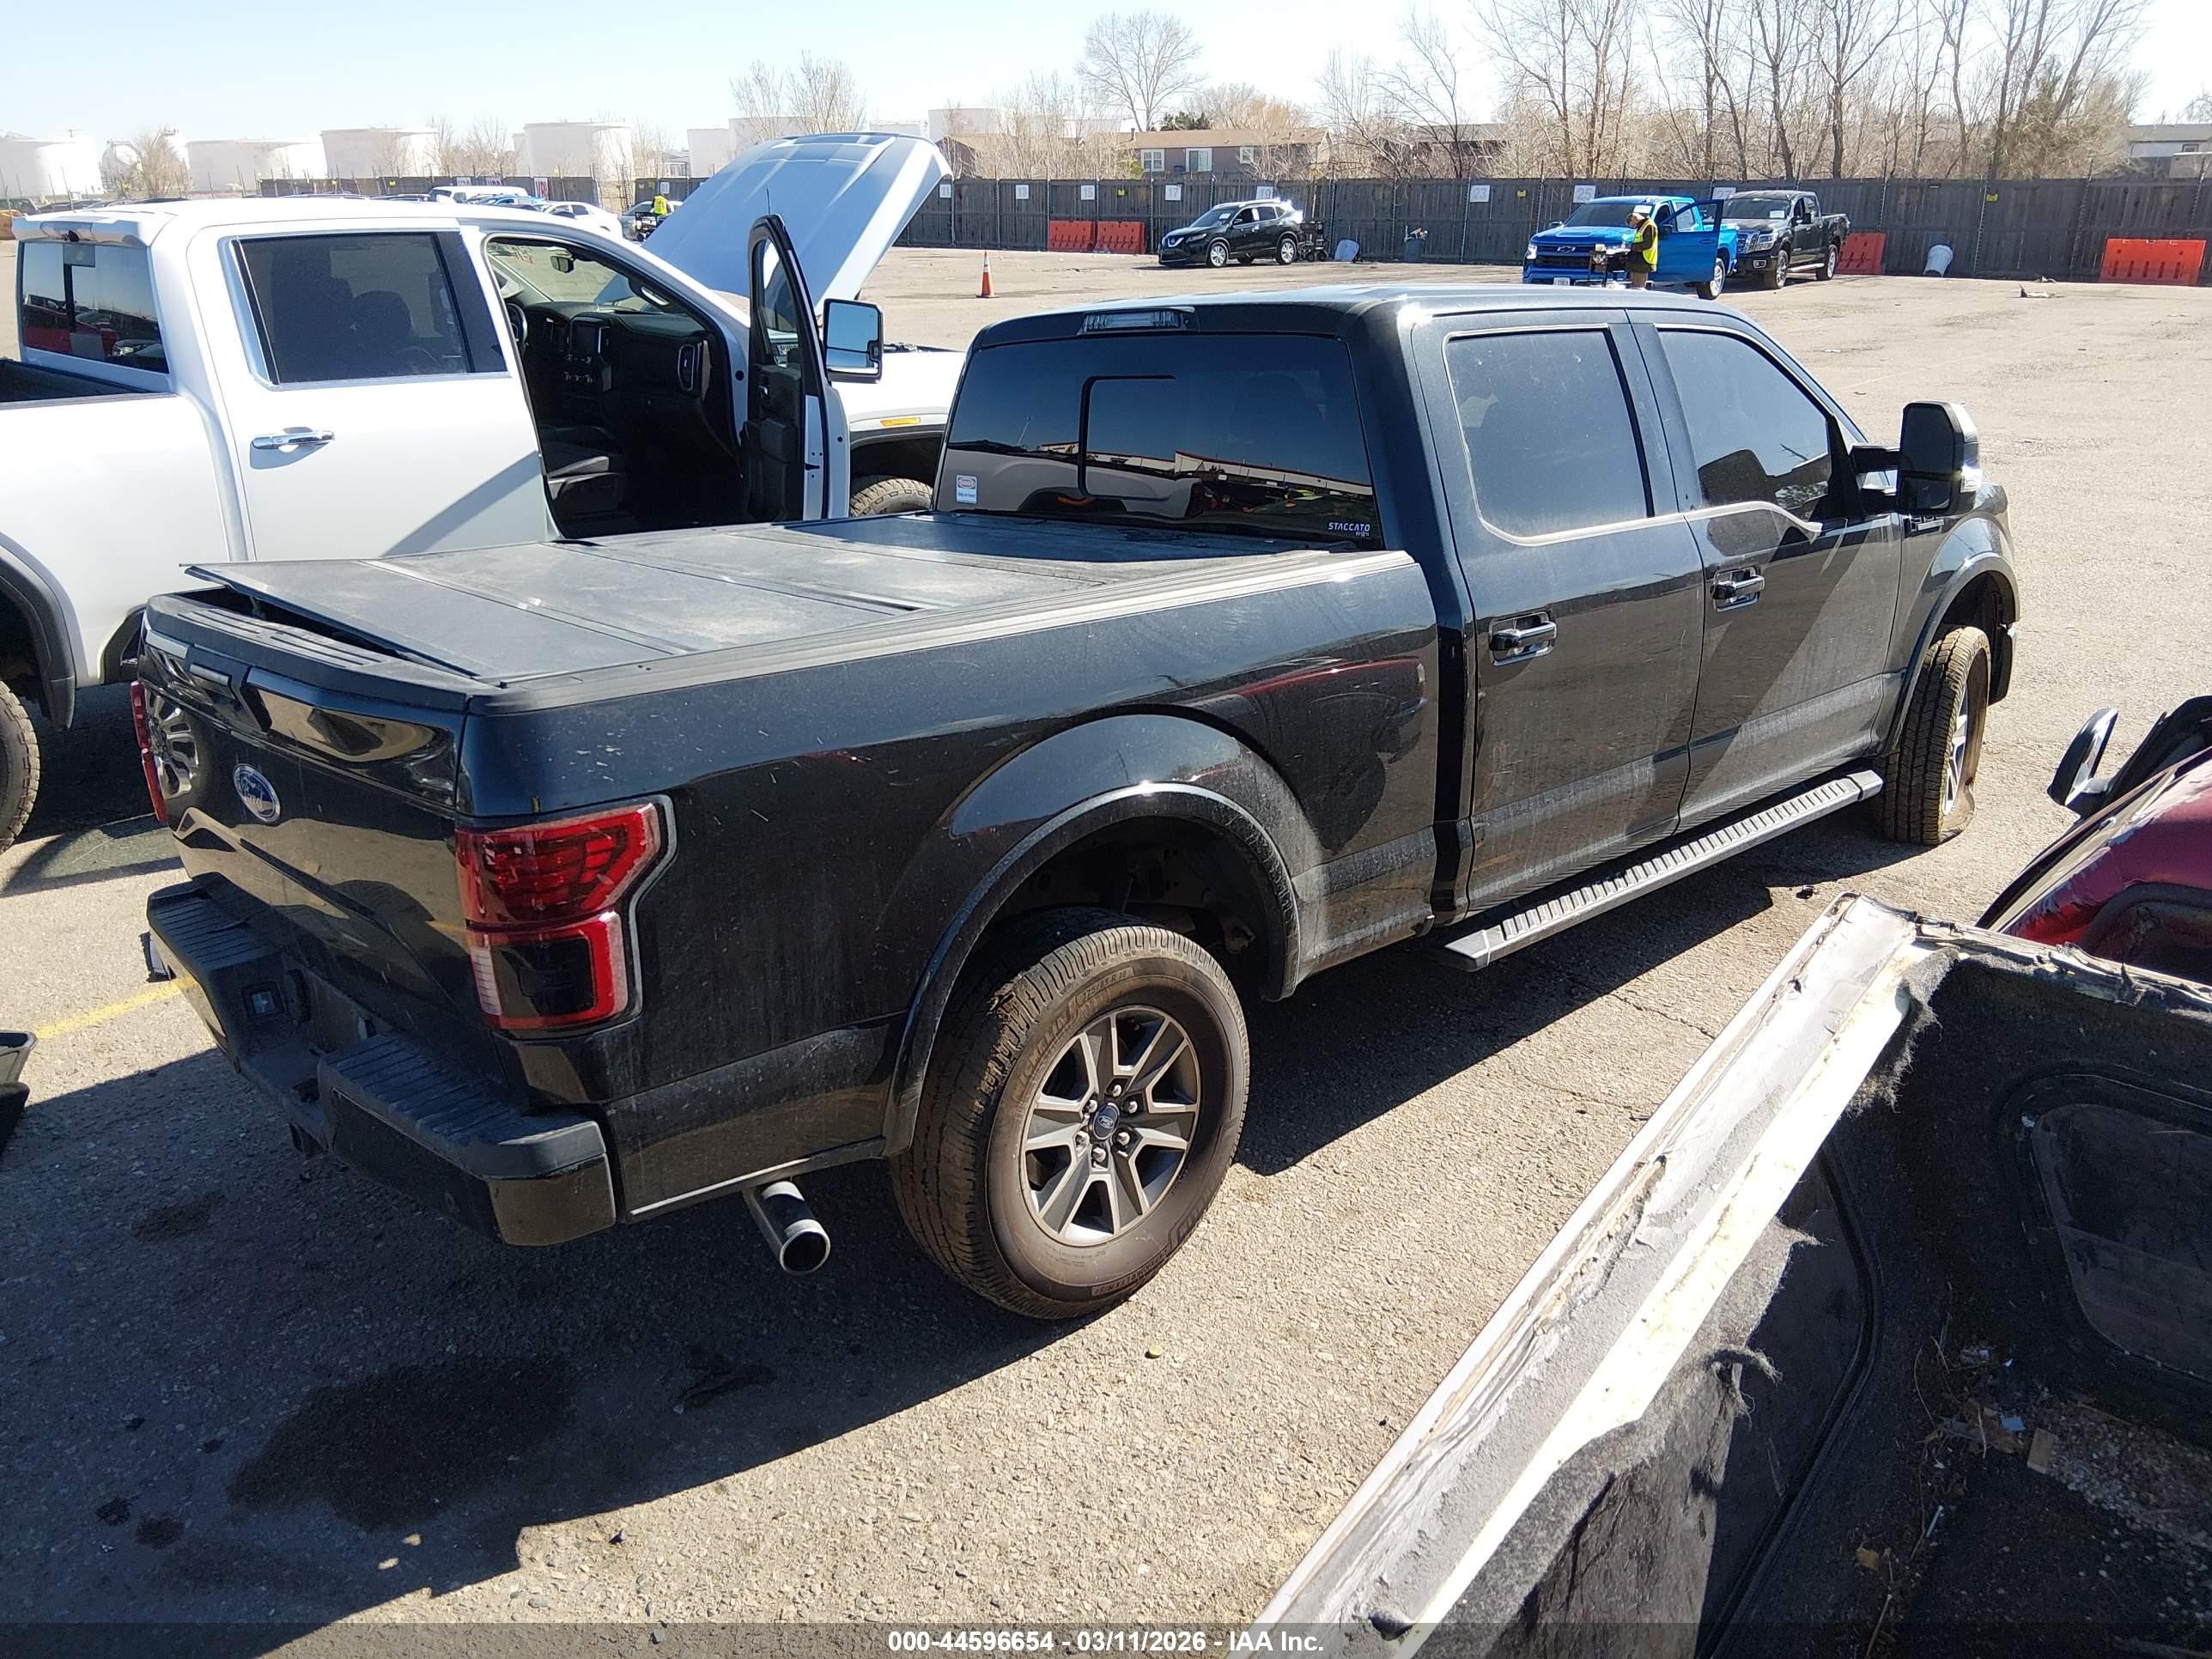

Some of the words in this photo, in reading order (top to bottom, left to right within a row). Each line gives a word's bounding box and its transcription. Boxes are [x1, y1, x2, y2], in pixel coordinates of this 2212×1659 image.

[1474, 188, 1486, 198] 23
[1577, 188, 1591, 199] 25
[1328, 521, 1370, 532] STACCATO
